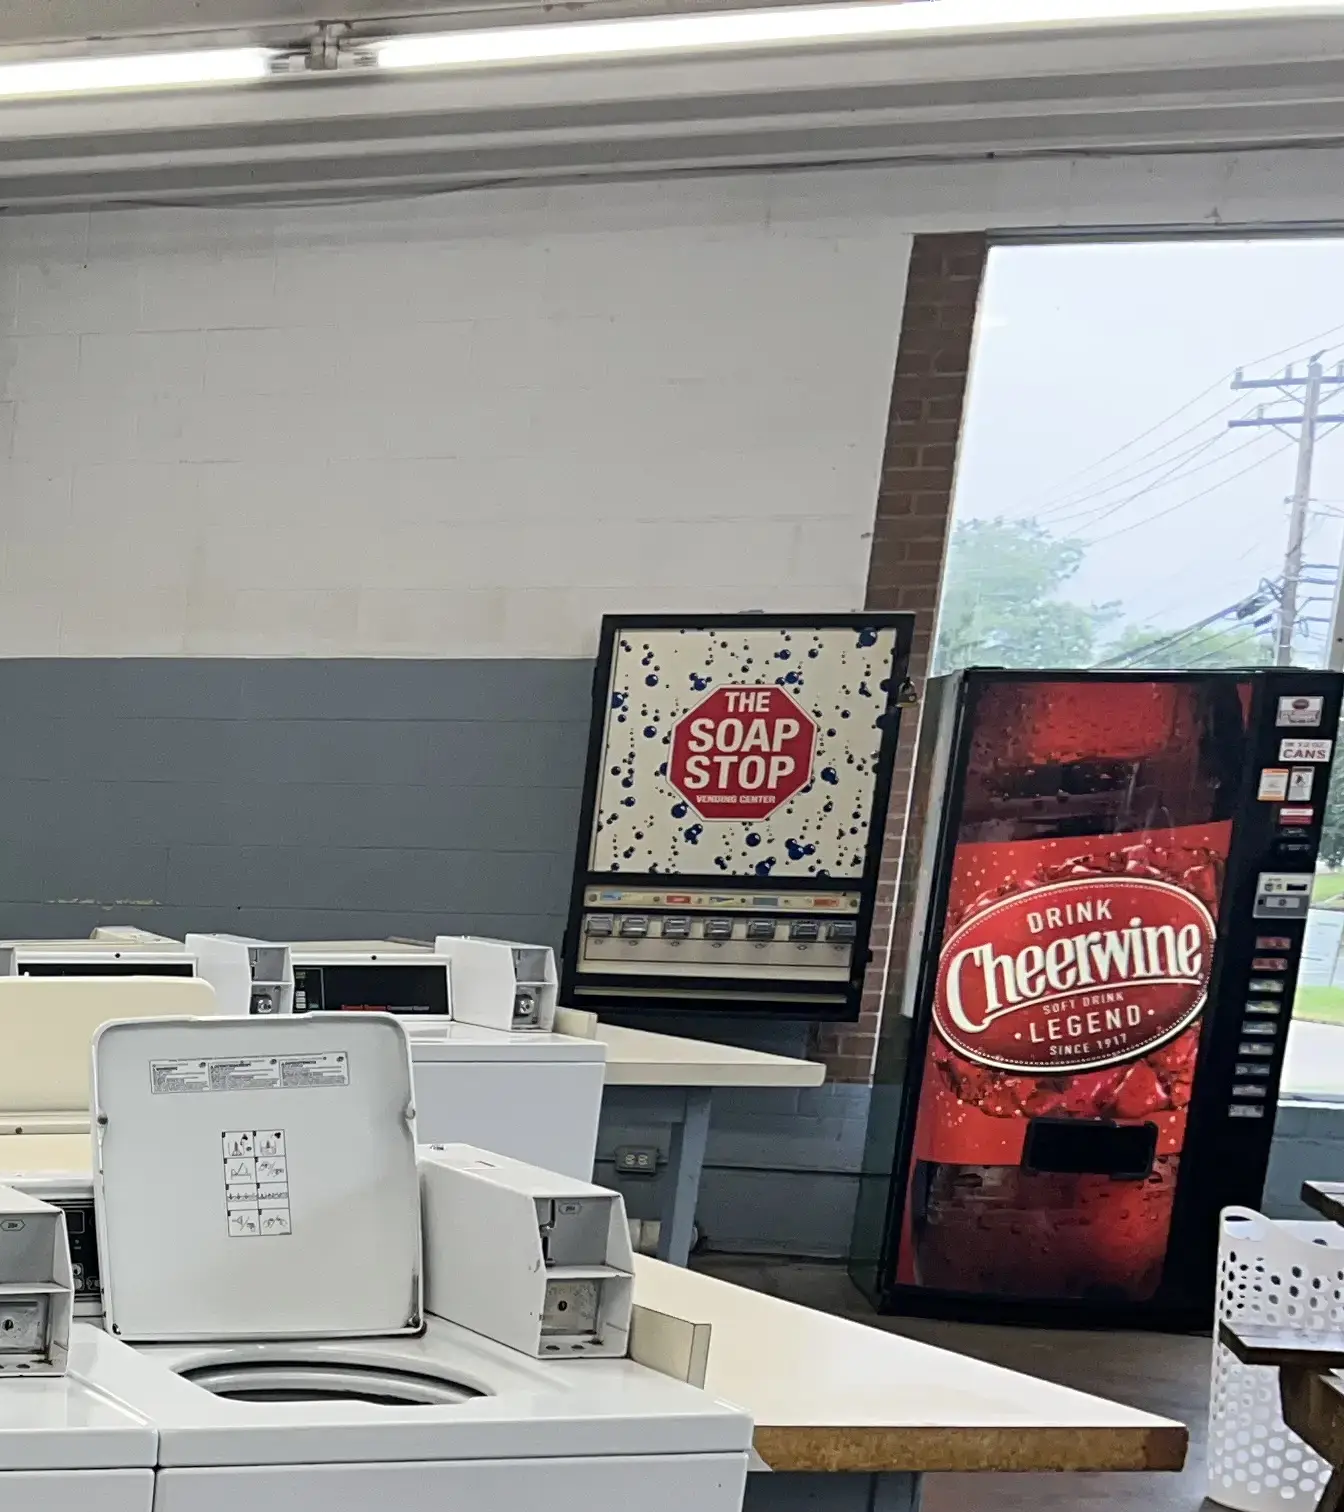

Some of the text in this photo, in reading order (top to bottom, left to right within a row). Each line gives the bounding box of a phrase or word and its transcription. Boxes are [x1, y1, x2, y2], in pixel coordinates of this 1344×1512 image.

[724, 691, 772, 713] THE
[687, 717, 801, 753] SOAP
[1283, 748, 1326, 760] CANS
[683, 755, 796, 790] STOP
[695, 794, 776, 804] VENDING CENTER
[1026, 898, 1113, 934] DRINK
[946, 916, 1203, 1034] Cheerwine
[1042, 992, 1124, 1015] SOFT DRINK
[1029, 1004, 1142, 1043] LEGEND
[1049, 1033, 1128, 1056] SINCE 1917
